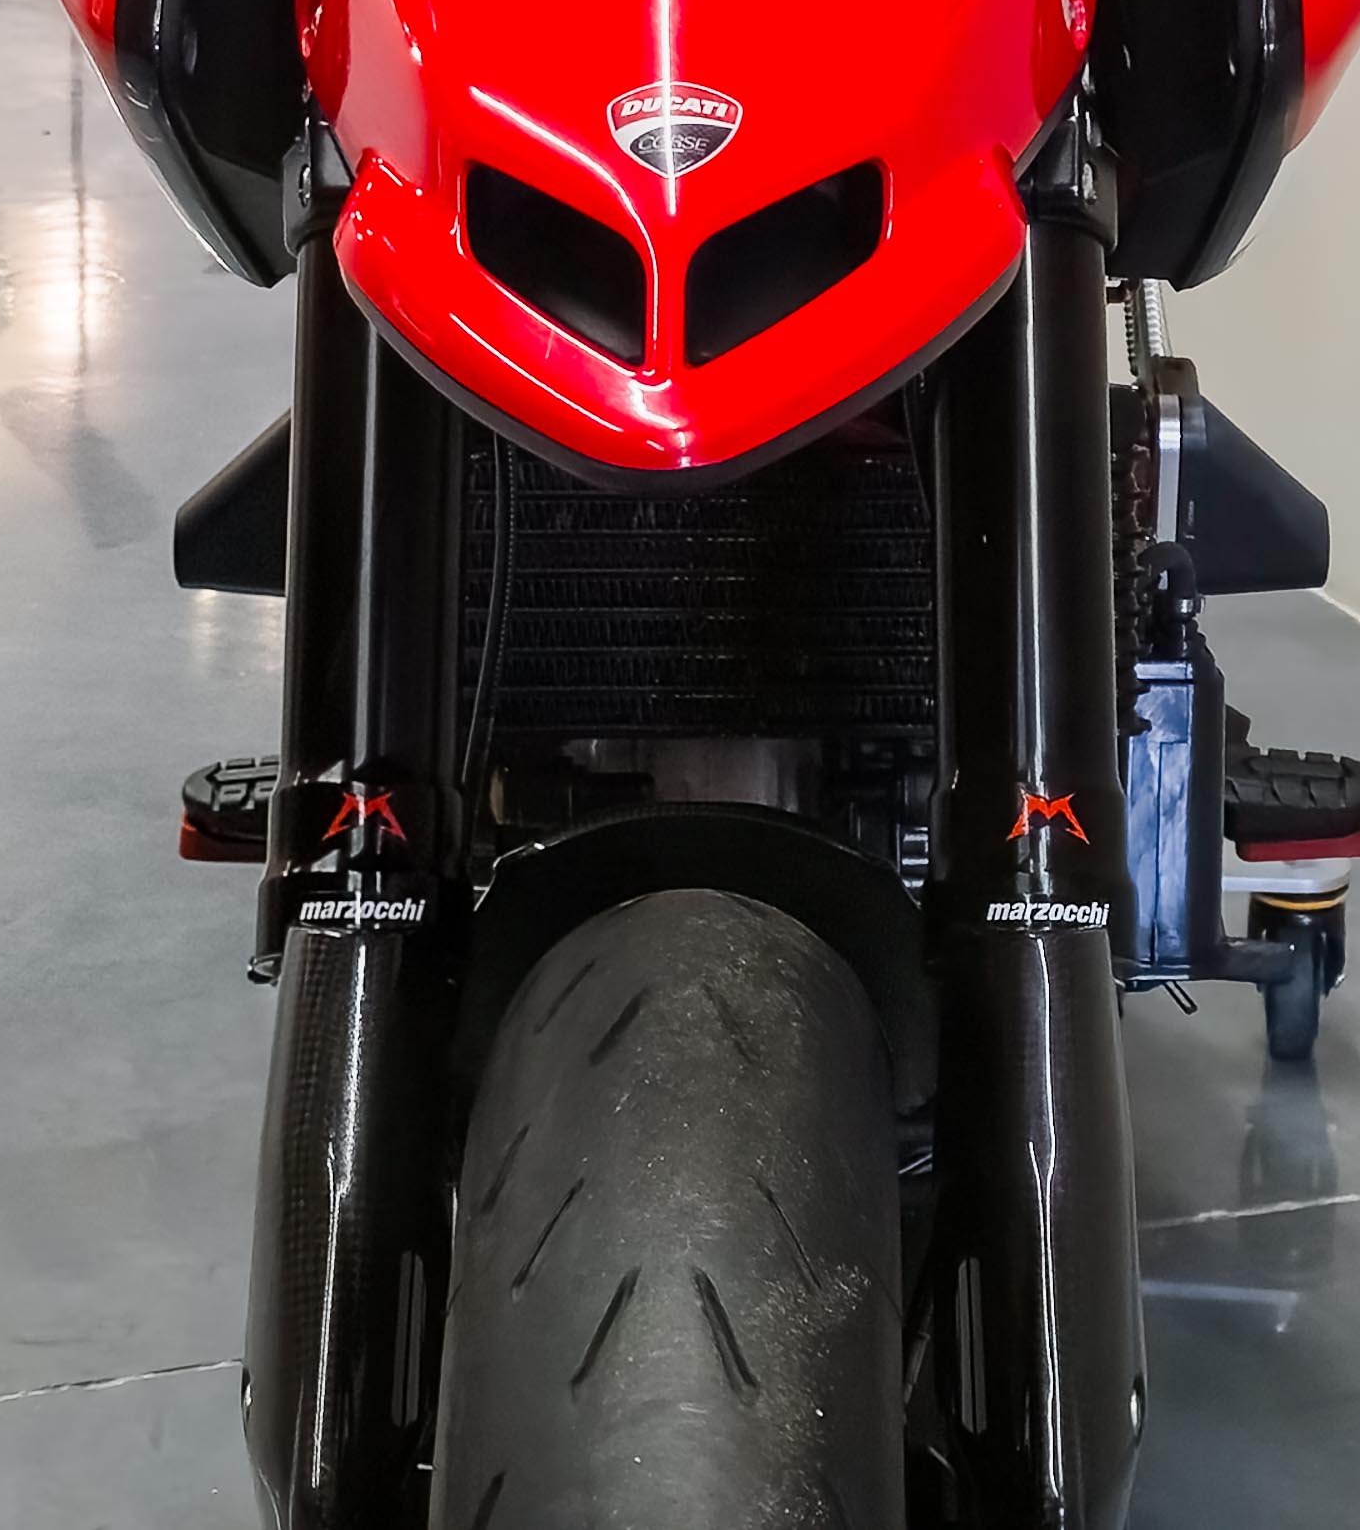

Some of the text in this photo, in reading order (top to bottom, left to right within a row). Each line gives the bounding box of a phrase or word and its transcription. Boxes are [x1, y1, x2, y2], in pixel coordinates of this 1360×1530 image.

[620, 96, 729, 118] DUCATI
[638, 133, 710, 153] CORSE
[299, 898, 426, 921] marzocchi
[986, 901, 1110, 926] marzocchi
